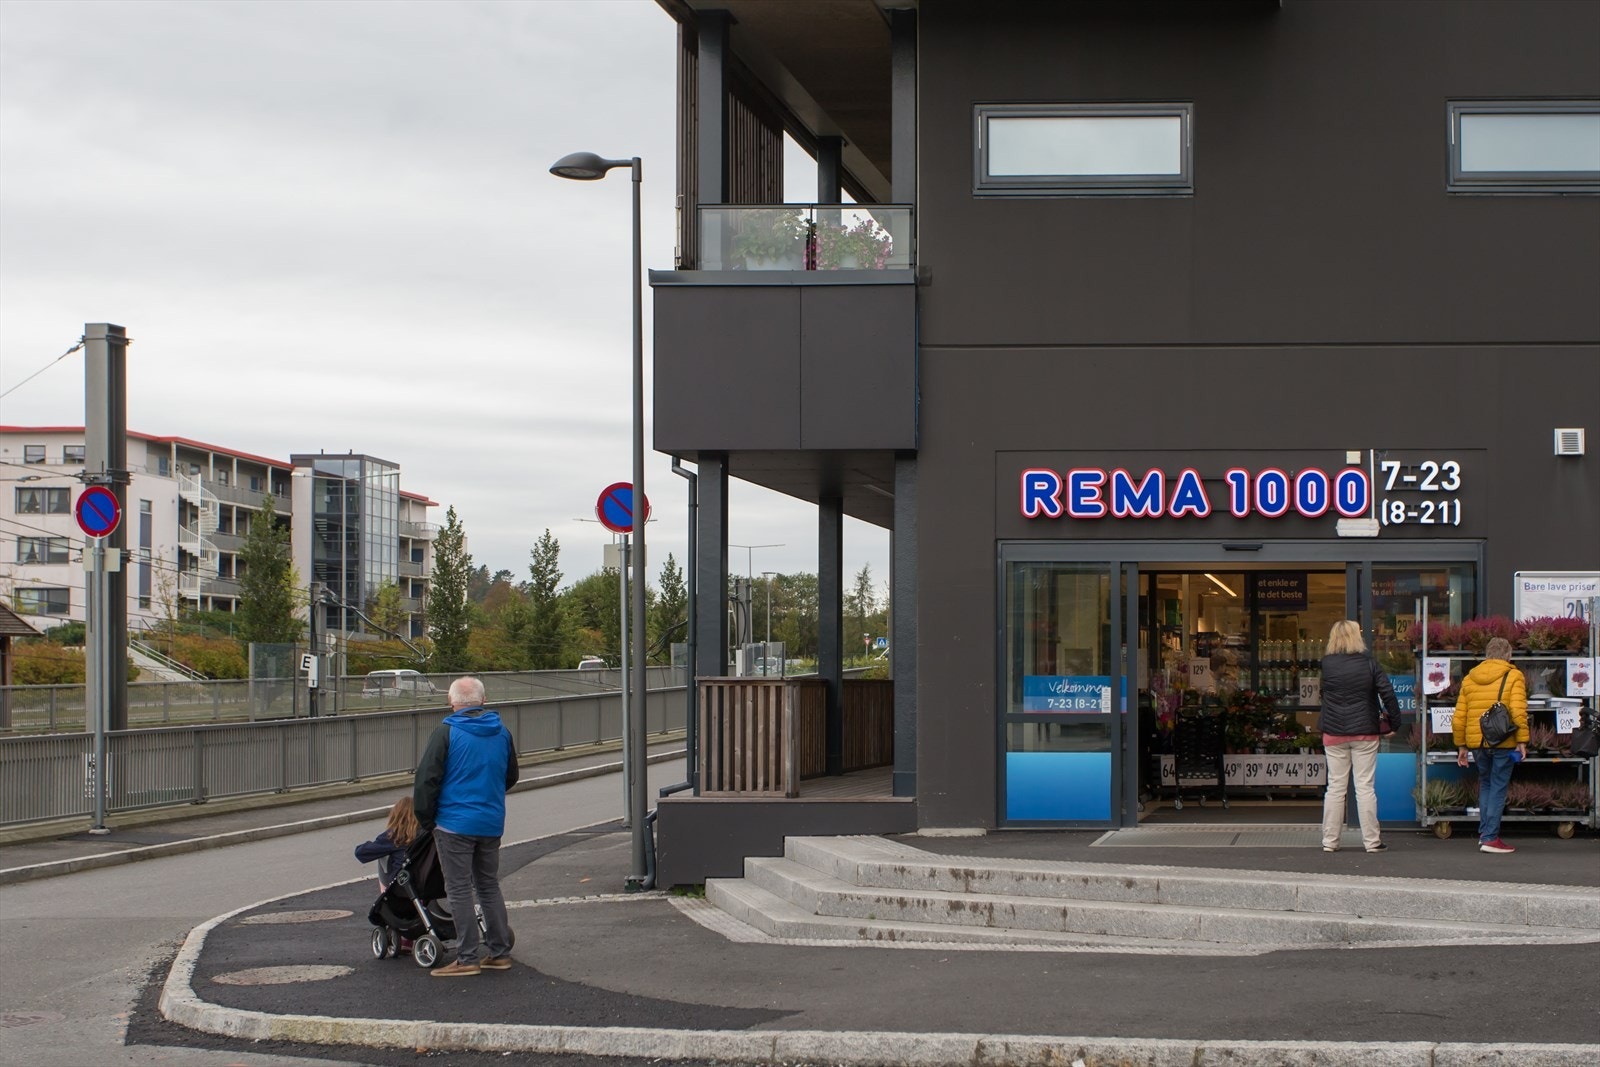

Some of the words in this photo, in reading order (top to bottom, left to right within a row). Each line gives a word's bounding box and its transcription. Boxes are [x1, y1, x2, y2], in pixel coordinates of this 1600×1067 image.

[1381, 460, 1461, 491] 7-23
[1020, 468, 1211, 519] REMA
[1224, 468, 1370, 519] 1000
[1381, 498, 1461, 526] (8-21)
[1268, 579, 1288, 587] enkle
[1524, 582, 1546, 591] Bare
[1547, 582, 1567, 591] lave
[1569, 582, 1596, 592] priser
[1266, 590, 1280, 599] det
[1281, 590, 1303, 599] beste
[302, 655, 311, 669] E
[1047, 698, 1072, 709] 7-23
[1075, 698, 1102, 709] (8-21
